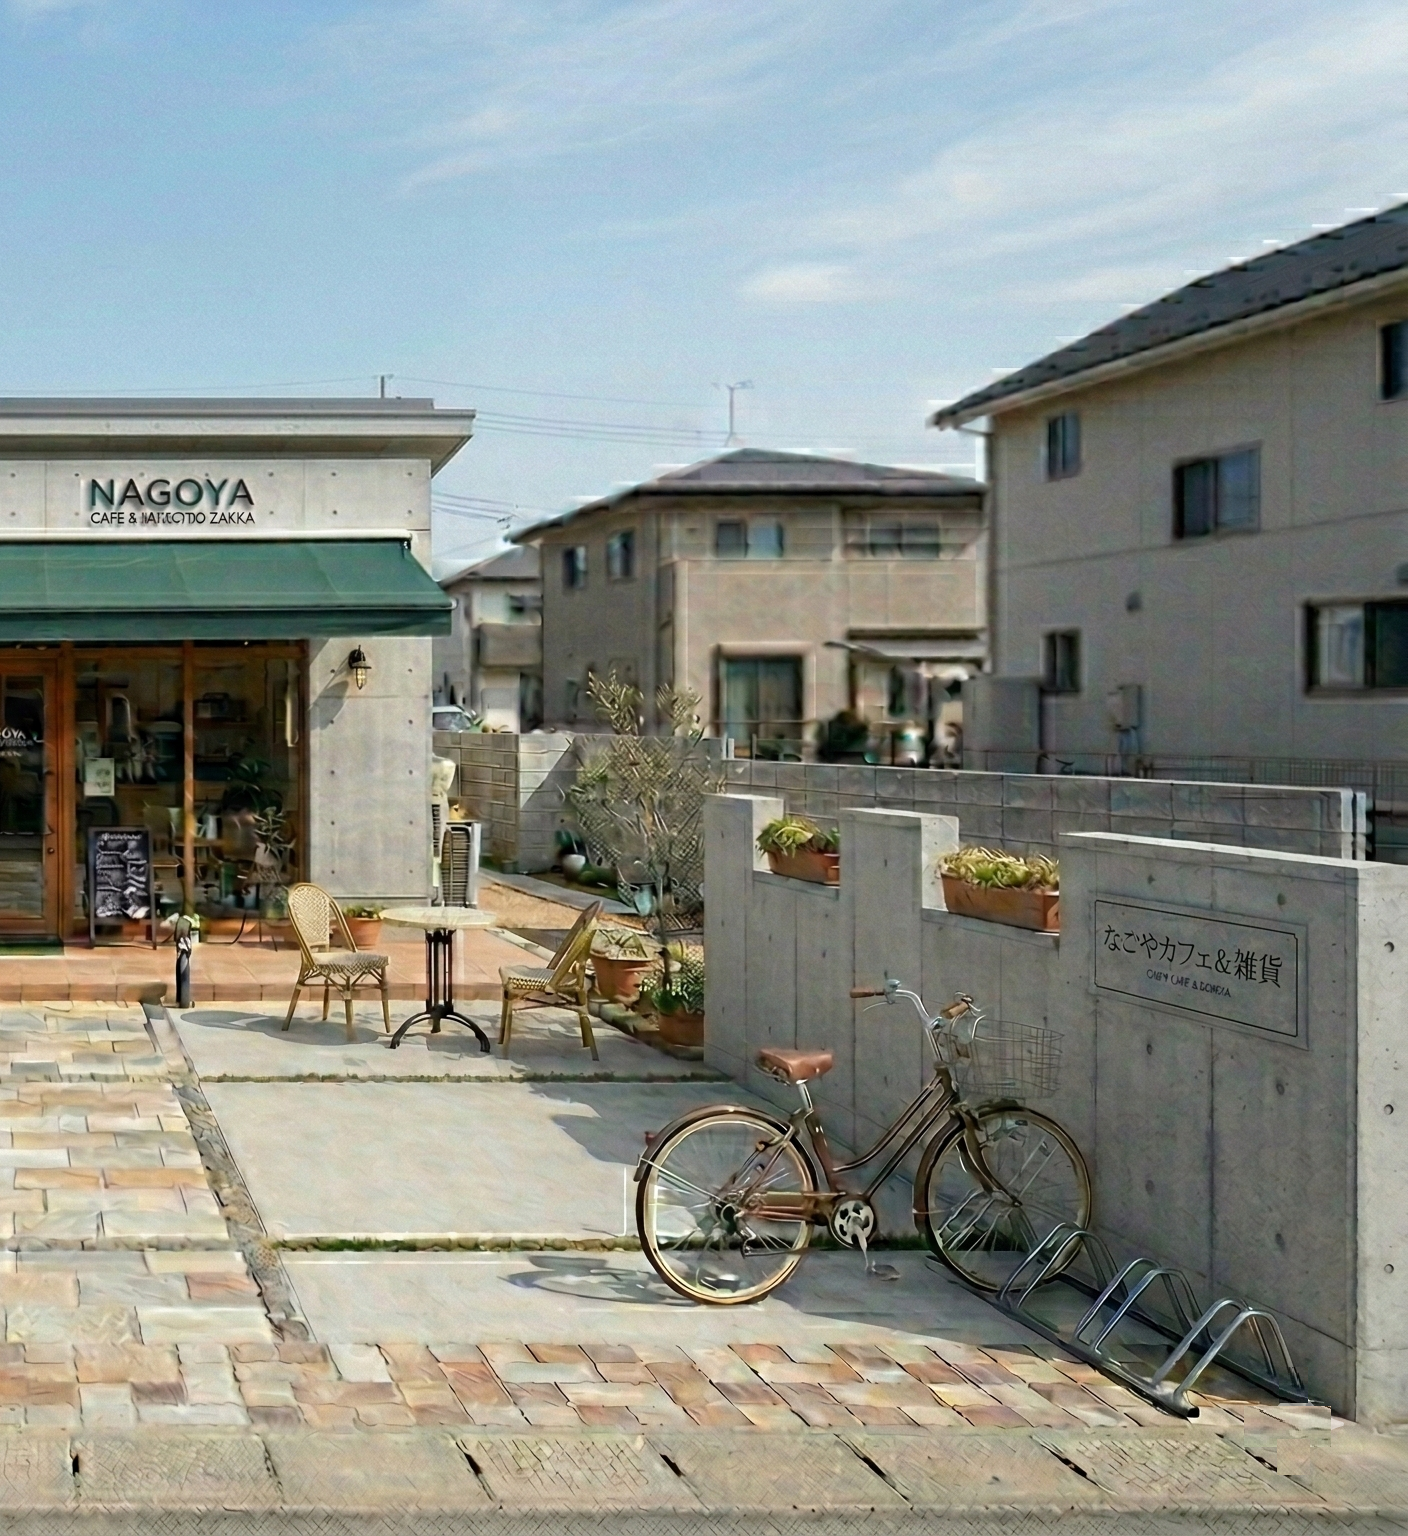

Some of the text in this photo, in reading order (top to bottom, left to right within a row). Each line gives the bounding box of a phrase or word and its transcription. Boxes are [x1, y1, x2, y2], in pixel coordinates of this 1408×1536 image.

[90, 478, 254, 506] NAGOYA
[90, 512, 124, 524] CAFE
[128, 512, 137, 524] &
[210, 512, 255, 524] ZAKKA
[1104, 924, 1283, 988] なごやカフェ&雑貨
